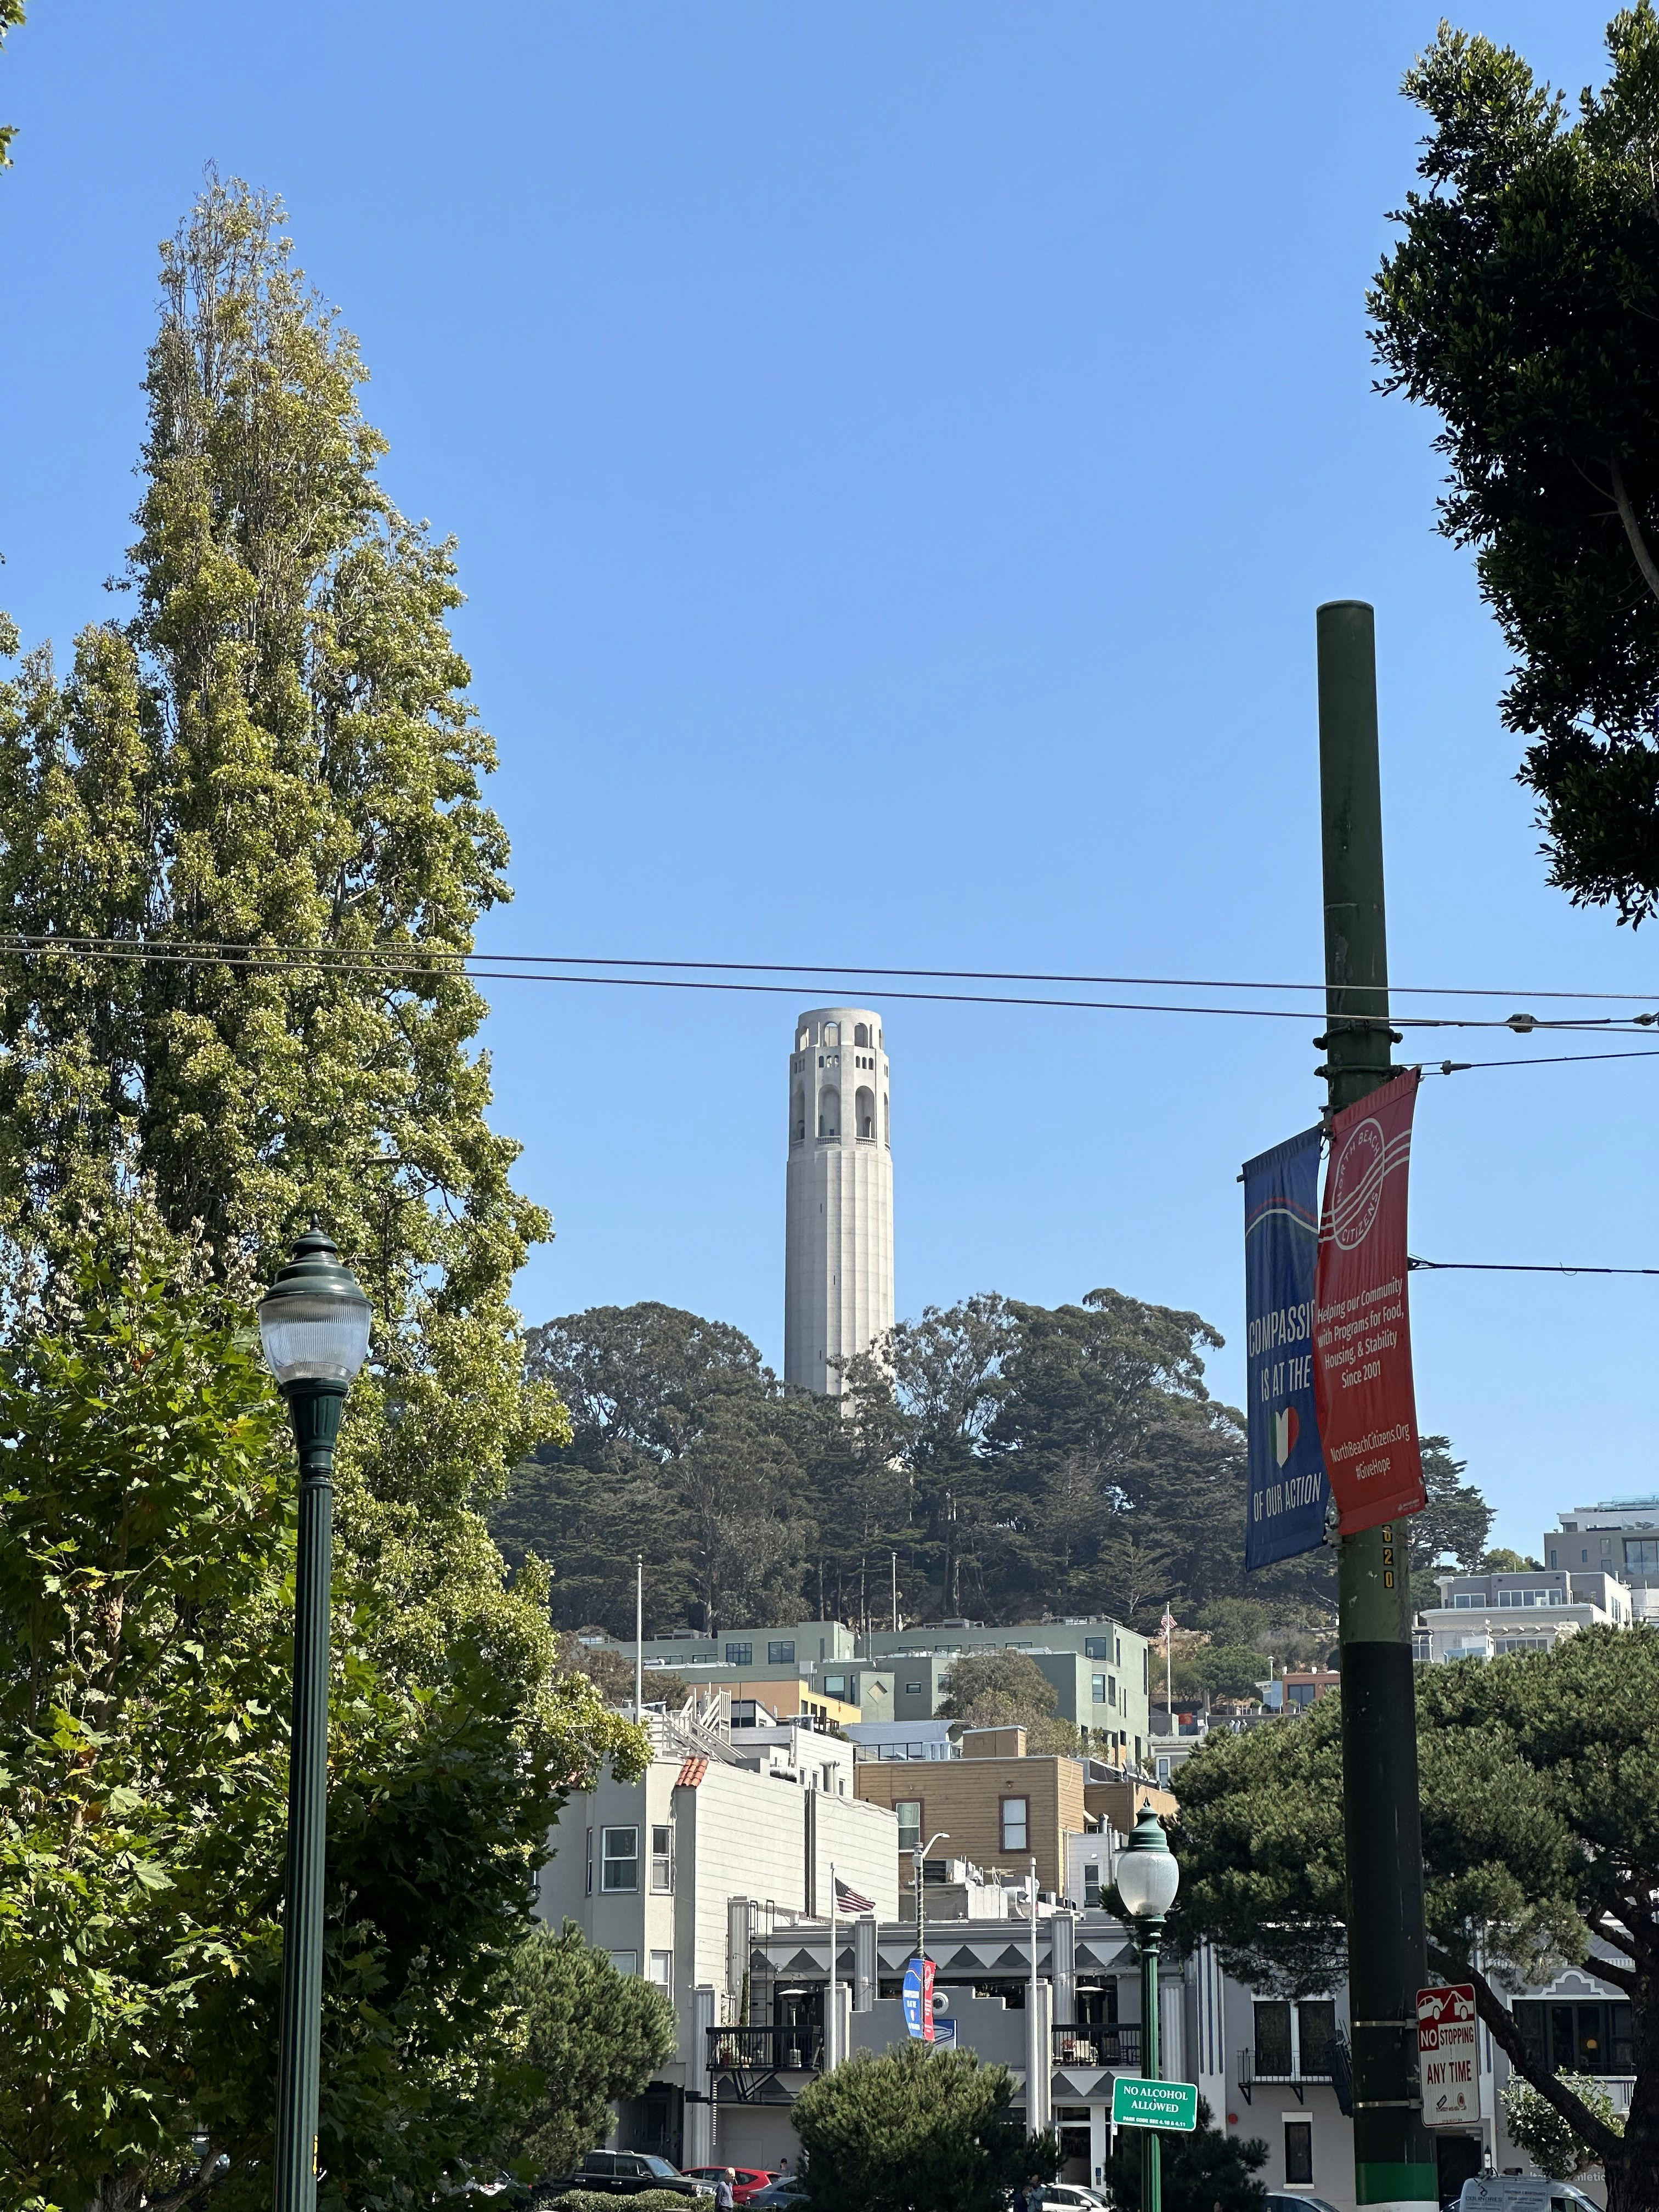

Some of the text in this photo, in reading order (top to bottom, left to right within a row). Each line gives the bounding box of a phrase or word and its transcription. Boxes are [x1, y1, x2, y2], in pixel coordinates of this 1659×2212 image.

[1337, 1130, 1380, 1204] NORTH BEACH
[1342, 1192, 1378, 1242] CITIZENS
[1317, 1276, 1402, 1324] Helping our Community
[1318, 1300, 1404, 1348] with Programs for Food,
[1325, 1329, 1397, 1370] Housing, & Stability
[1261, 1355, 1312, 1402] IS AT THE
[1341, 1360, 1381, 1389] Since 2001
[1330, 1424, 1409, 1463] NorthBeachCitizens.Org
[1355, 1457, 1391, 1481] #GiveHope
[1254, 1472, 1322, 1522] OF OUR ACTION
[1420, 2027, 1474, 2047] NO STOPPING
[1427, 2060, 1471, 2085] ANY TIME
[1124, 2085, 1188, 2101] NO ALCOHOL
[1131, 2100, 1179, 2113] ALLOWED
